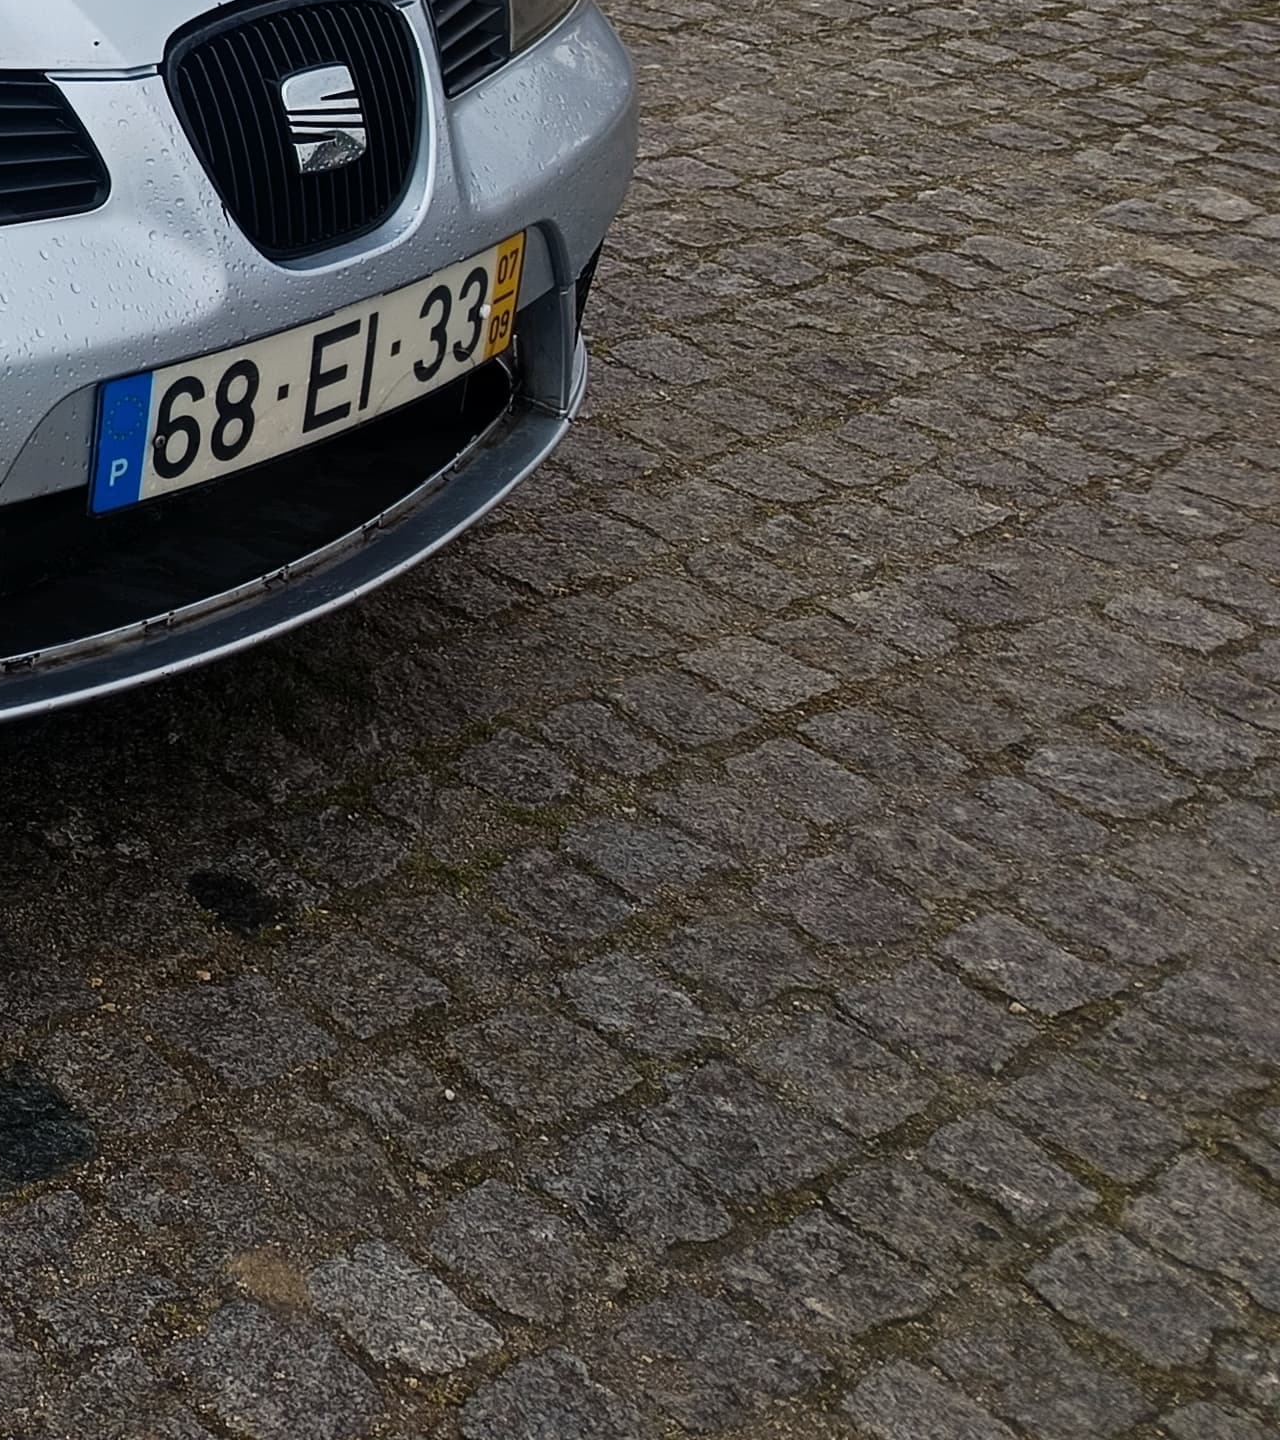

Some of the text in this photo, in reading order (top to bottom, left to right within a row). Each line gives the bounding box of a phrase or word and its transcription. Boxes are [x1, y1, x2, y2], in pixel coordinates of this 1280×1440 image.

[497, 247, 520, 285] 07
[488, 315, 509, 345] 09
[109, 458, 129, 487] P
